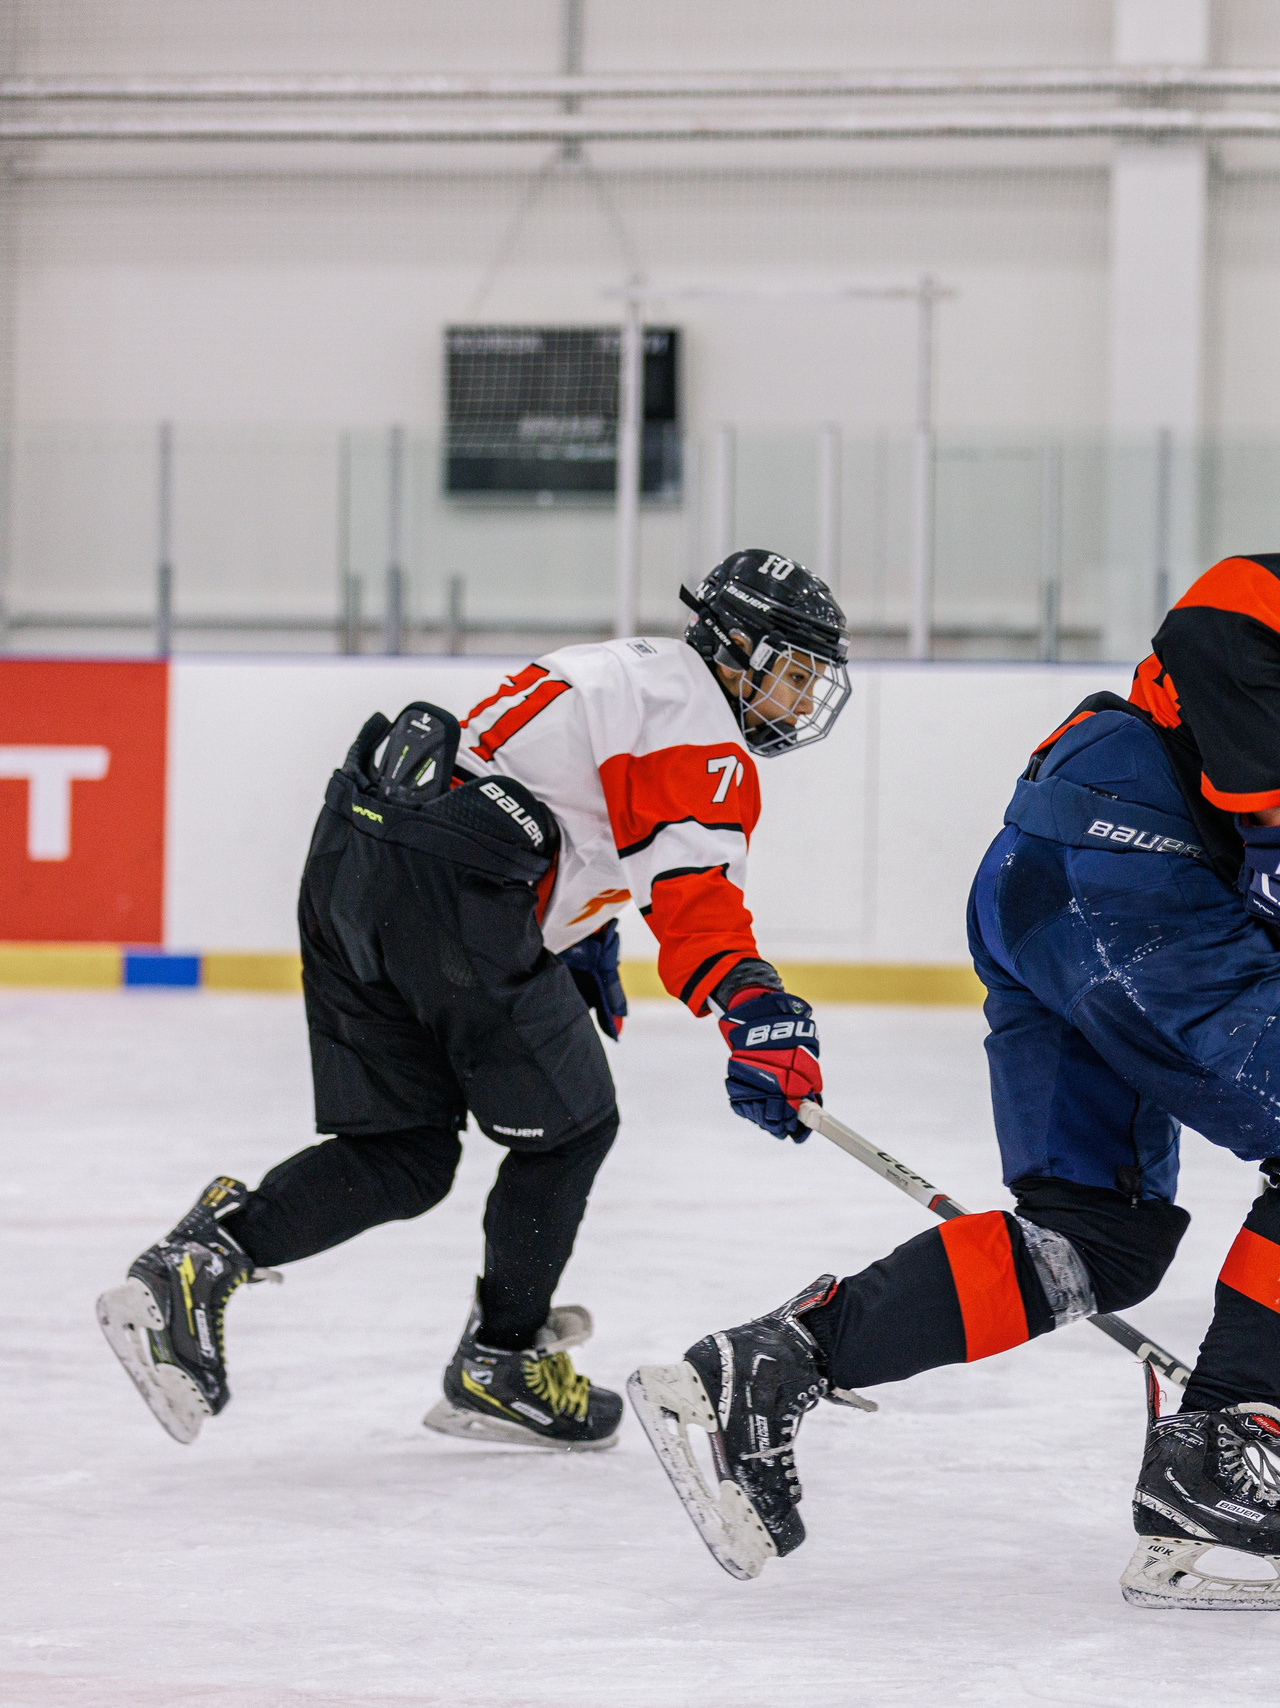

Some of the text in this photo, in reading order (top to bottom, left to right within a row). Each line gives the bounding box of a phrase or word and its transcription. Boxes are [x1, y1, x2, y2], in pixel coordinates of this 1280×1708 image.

[706, 754, 744, 804] 7
[479, 782, 544, 848] BAUER
[745, 1021, 820, 1047] BAU
[1218, 1501, 1265, 1522] BAUER
